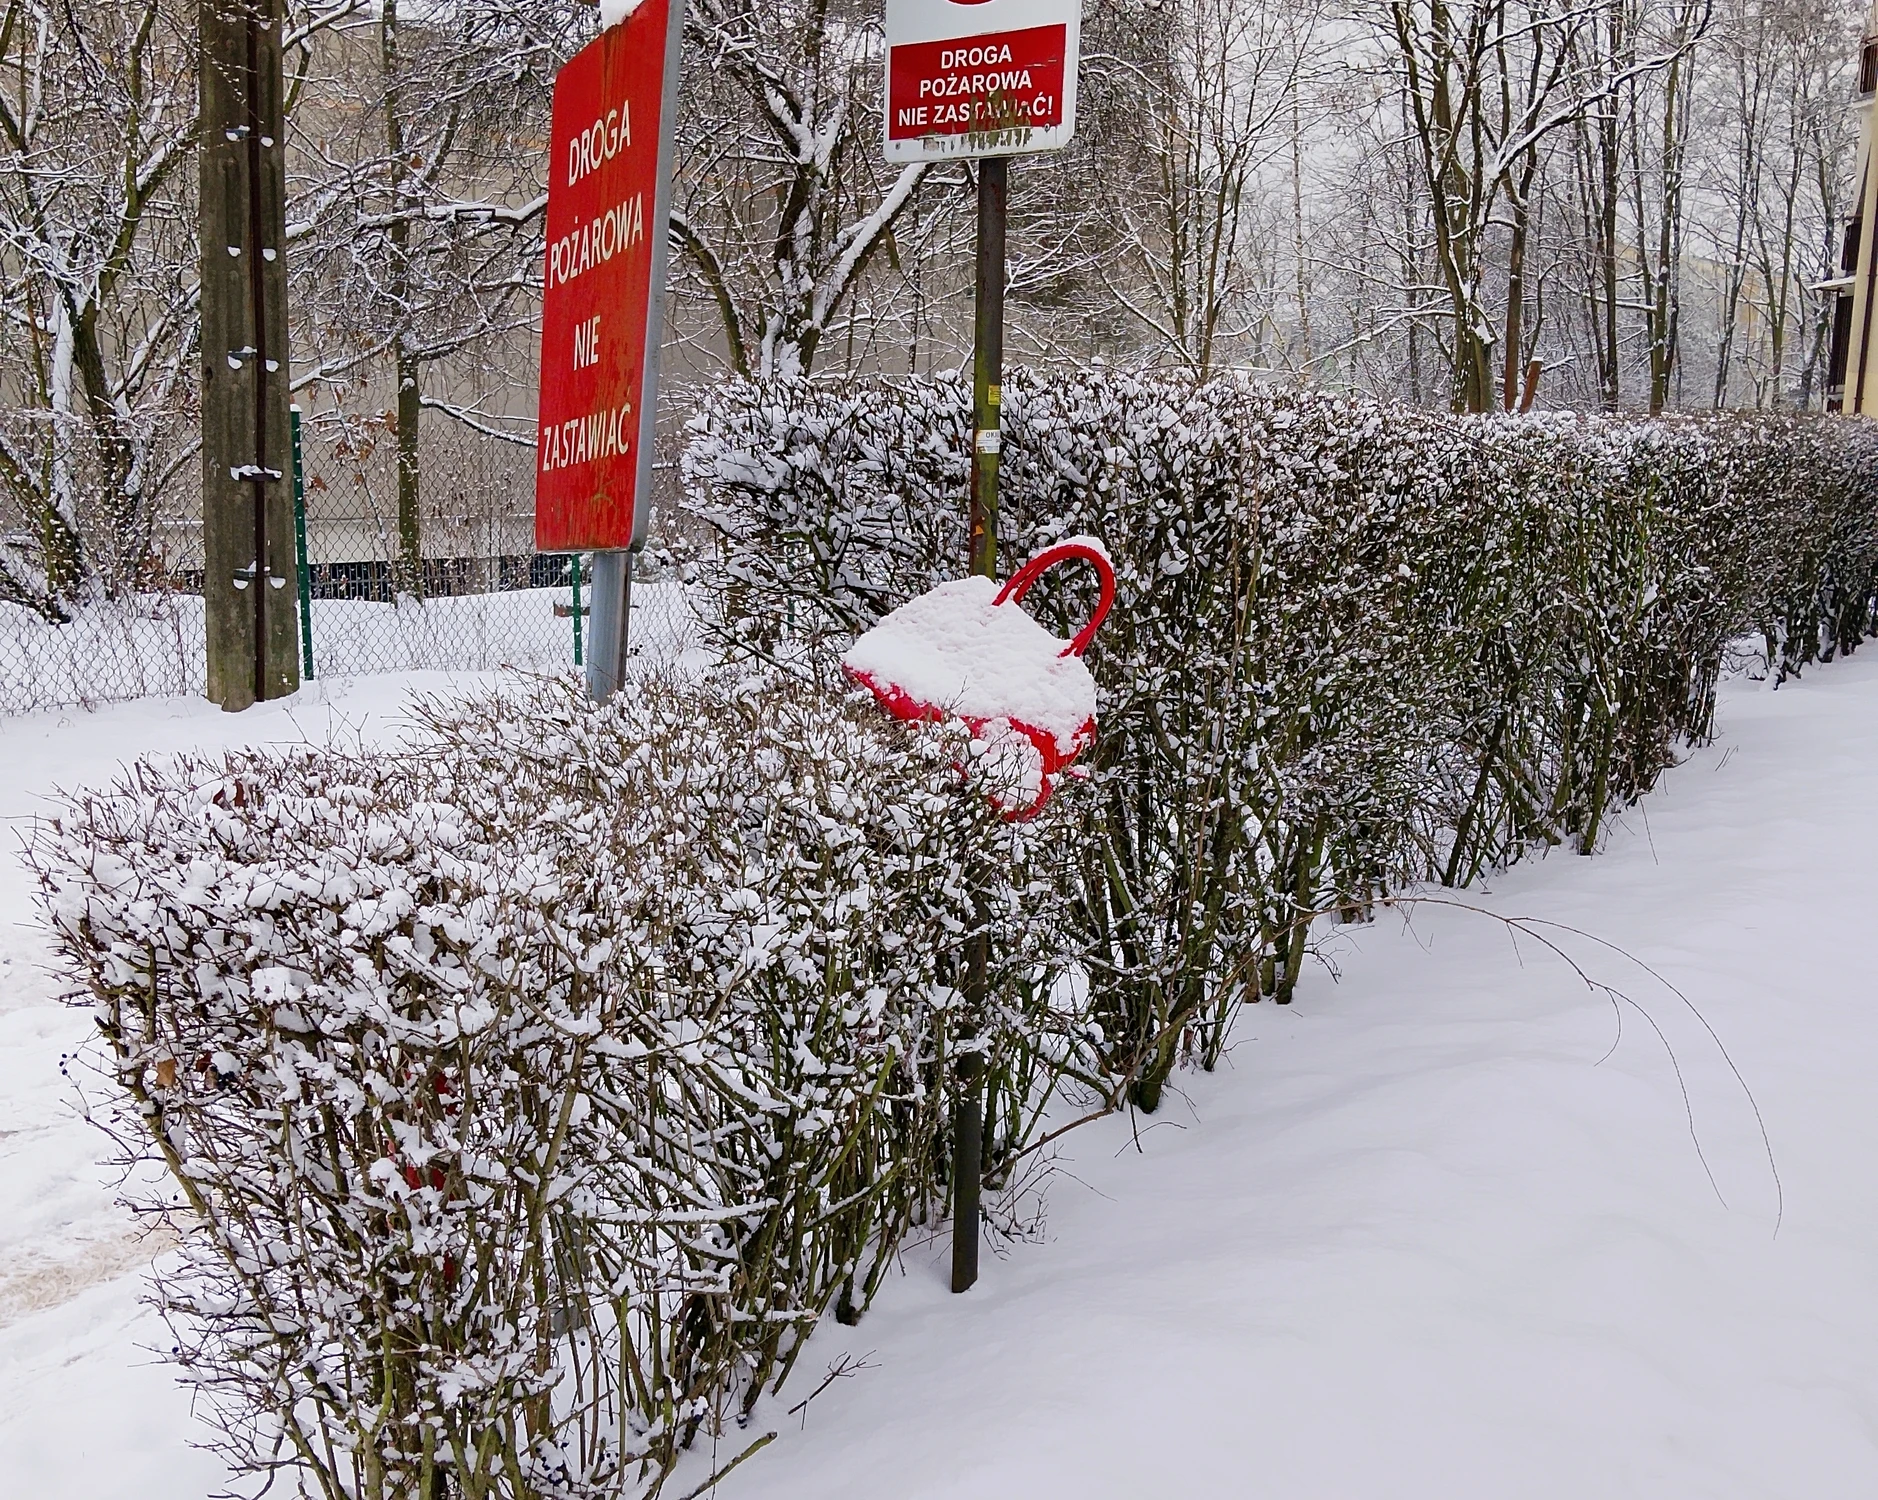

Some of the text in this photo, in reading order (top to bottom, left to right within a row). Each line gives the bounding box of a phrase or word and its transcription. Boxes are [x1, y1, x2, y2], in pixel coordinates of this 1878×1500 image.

[919, 70, 1032, 98] POŻAROWA
[940, 44, 1013, 69] DROGA
[568, 99, 631, 187] DROGA
[898, 106, 928, 126] NIE
[549, 191, 643, 289] POŻAROWA
[573, 315, 601, 371] NIE
[543, 385, 631, 471] ZASTAWIAĆ
